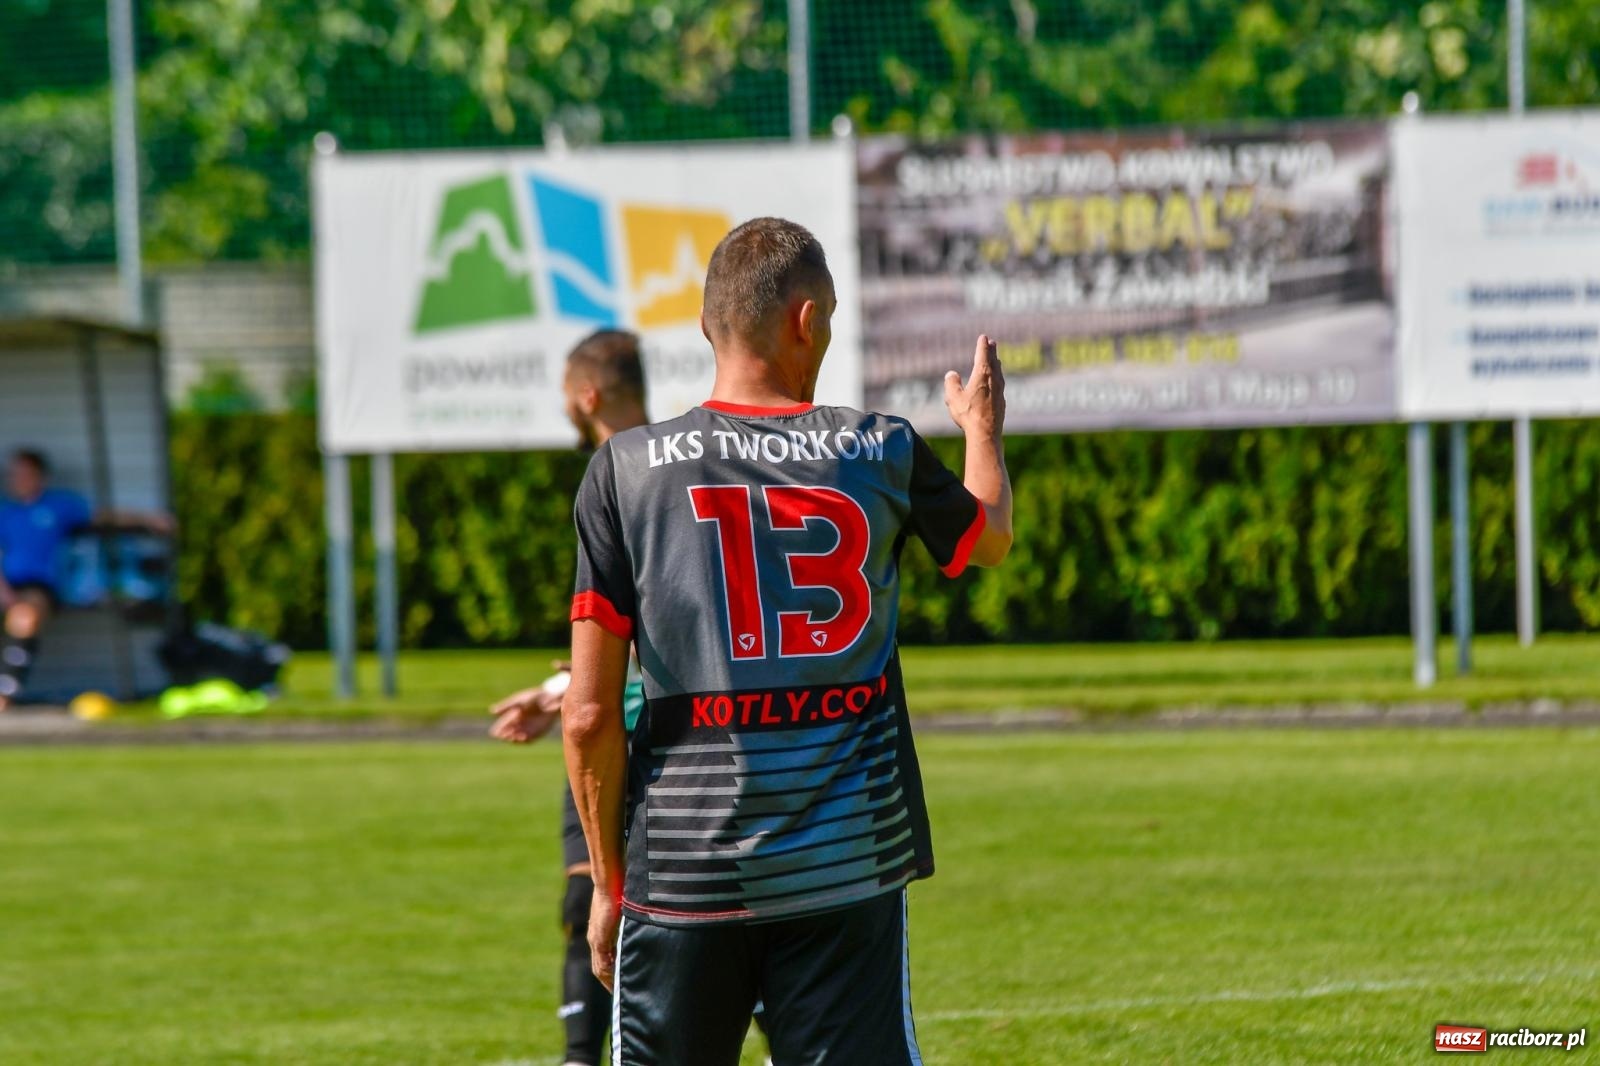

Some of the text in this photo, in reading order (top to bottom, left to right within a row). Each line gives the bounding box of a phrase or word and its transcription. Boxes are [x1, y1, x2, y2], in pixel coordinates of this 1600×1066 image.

[404, 347, 548, 392] powiat
[648, 426, 884, 468] LKS TWORKÓW
[687, 484, 872, 661] 13
